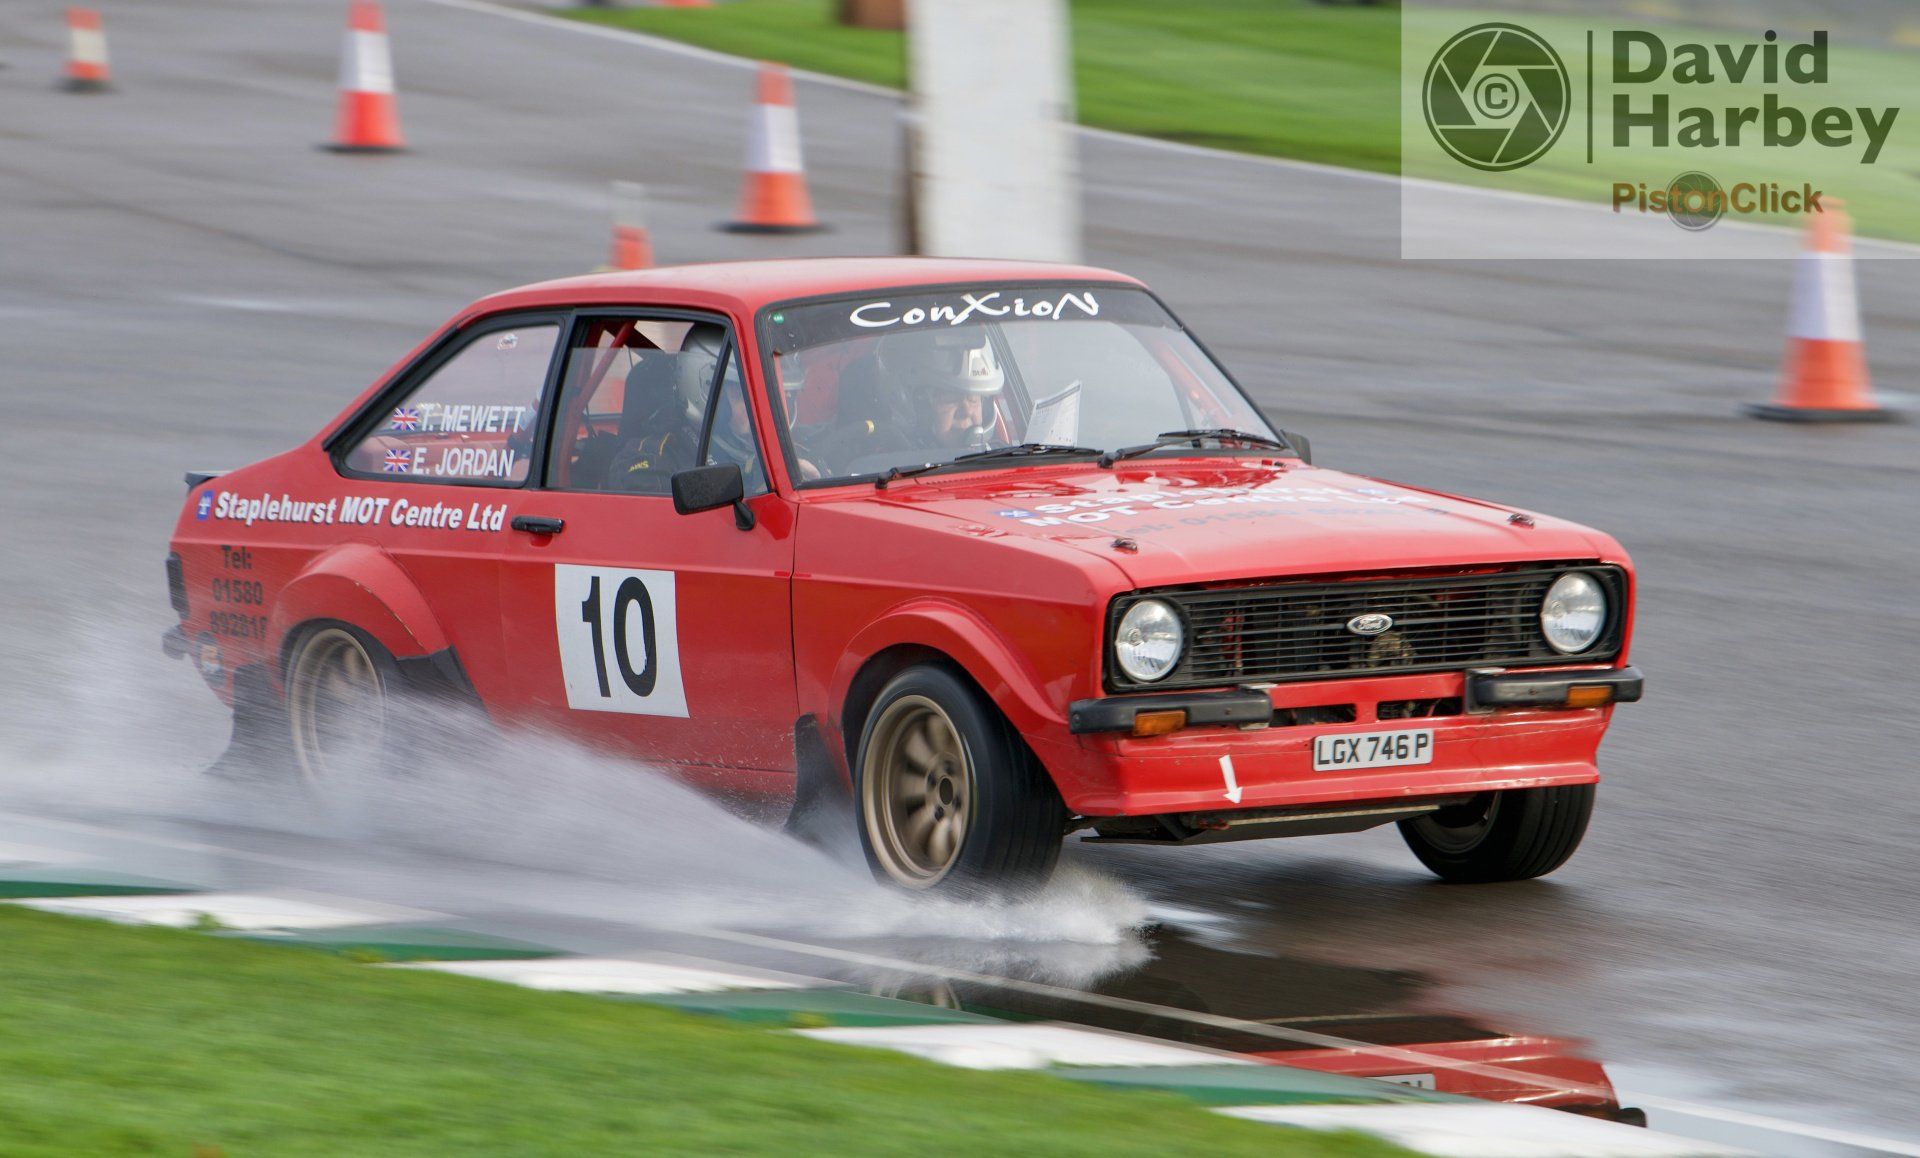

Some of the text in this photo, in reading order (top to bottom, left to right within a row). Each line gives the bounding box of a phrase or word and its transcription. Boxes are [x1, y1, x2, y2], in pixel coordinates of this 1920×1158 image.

[420, 404, 526, 433] T. MEWETT
[412, 447, 516, 478] E. JORDAN
[214, 491, 508, 533] Staplehurst MOT Centre Ltd
[1021, 505, 1139, 527] MOT
[220, 544, 253, 570] Tel:
[212, 577, 264, 606] 01580
[582, 576, 658, 698] 10
[1317, 731, 1430, 766] LGX 746 P
